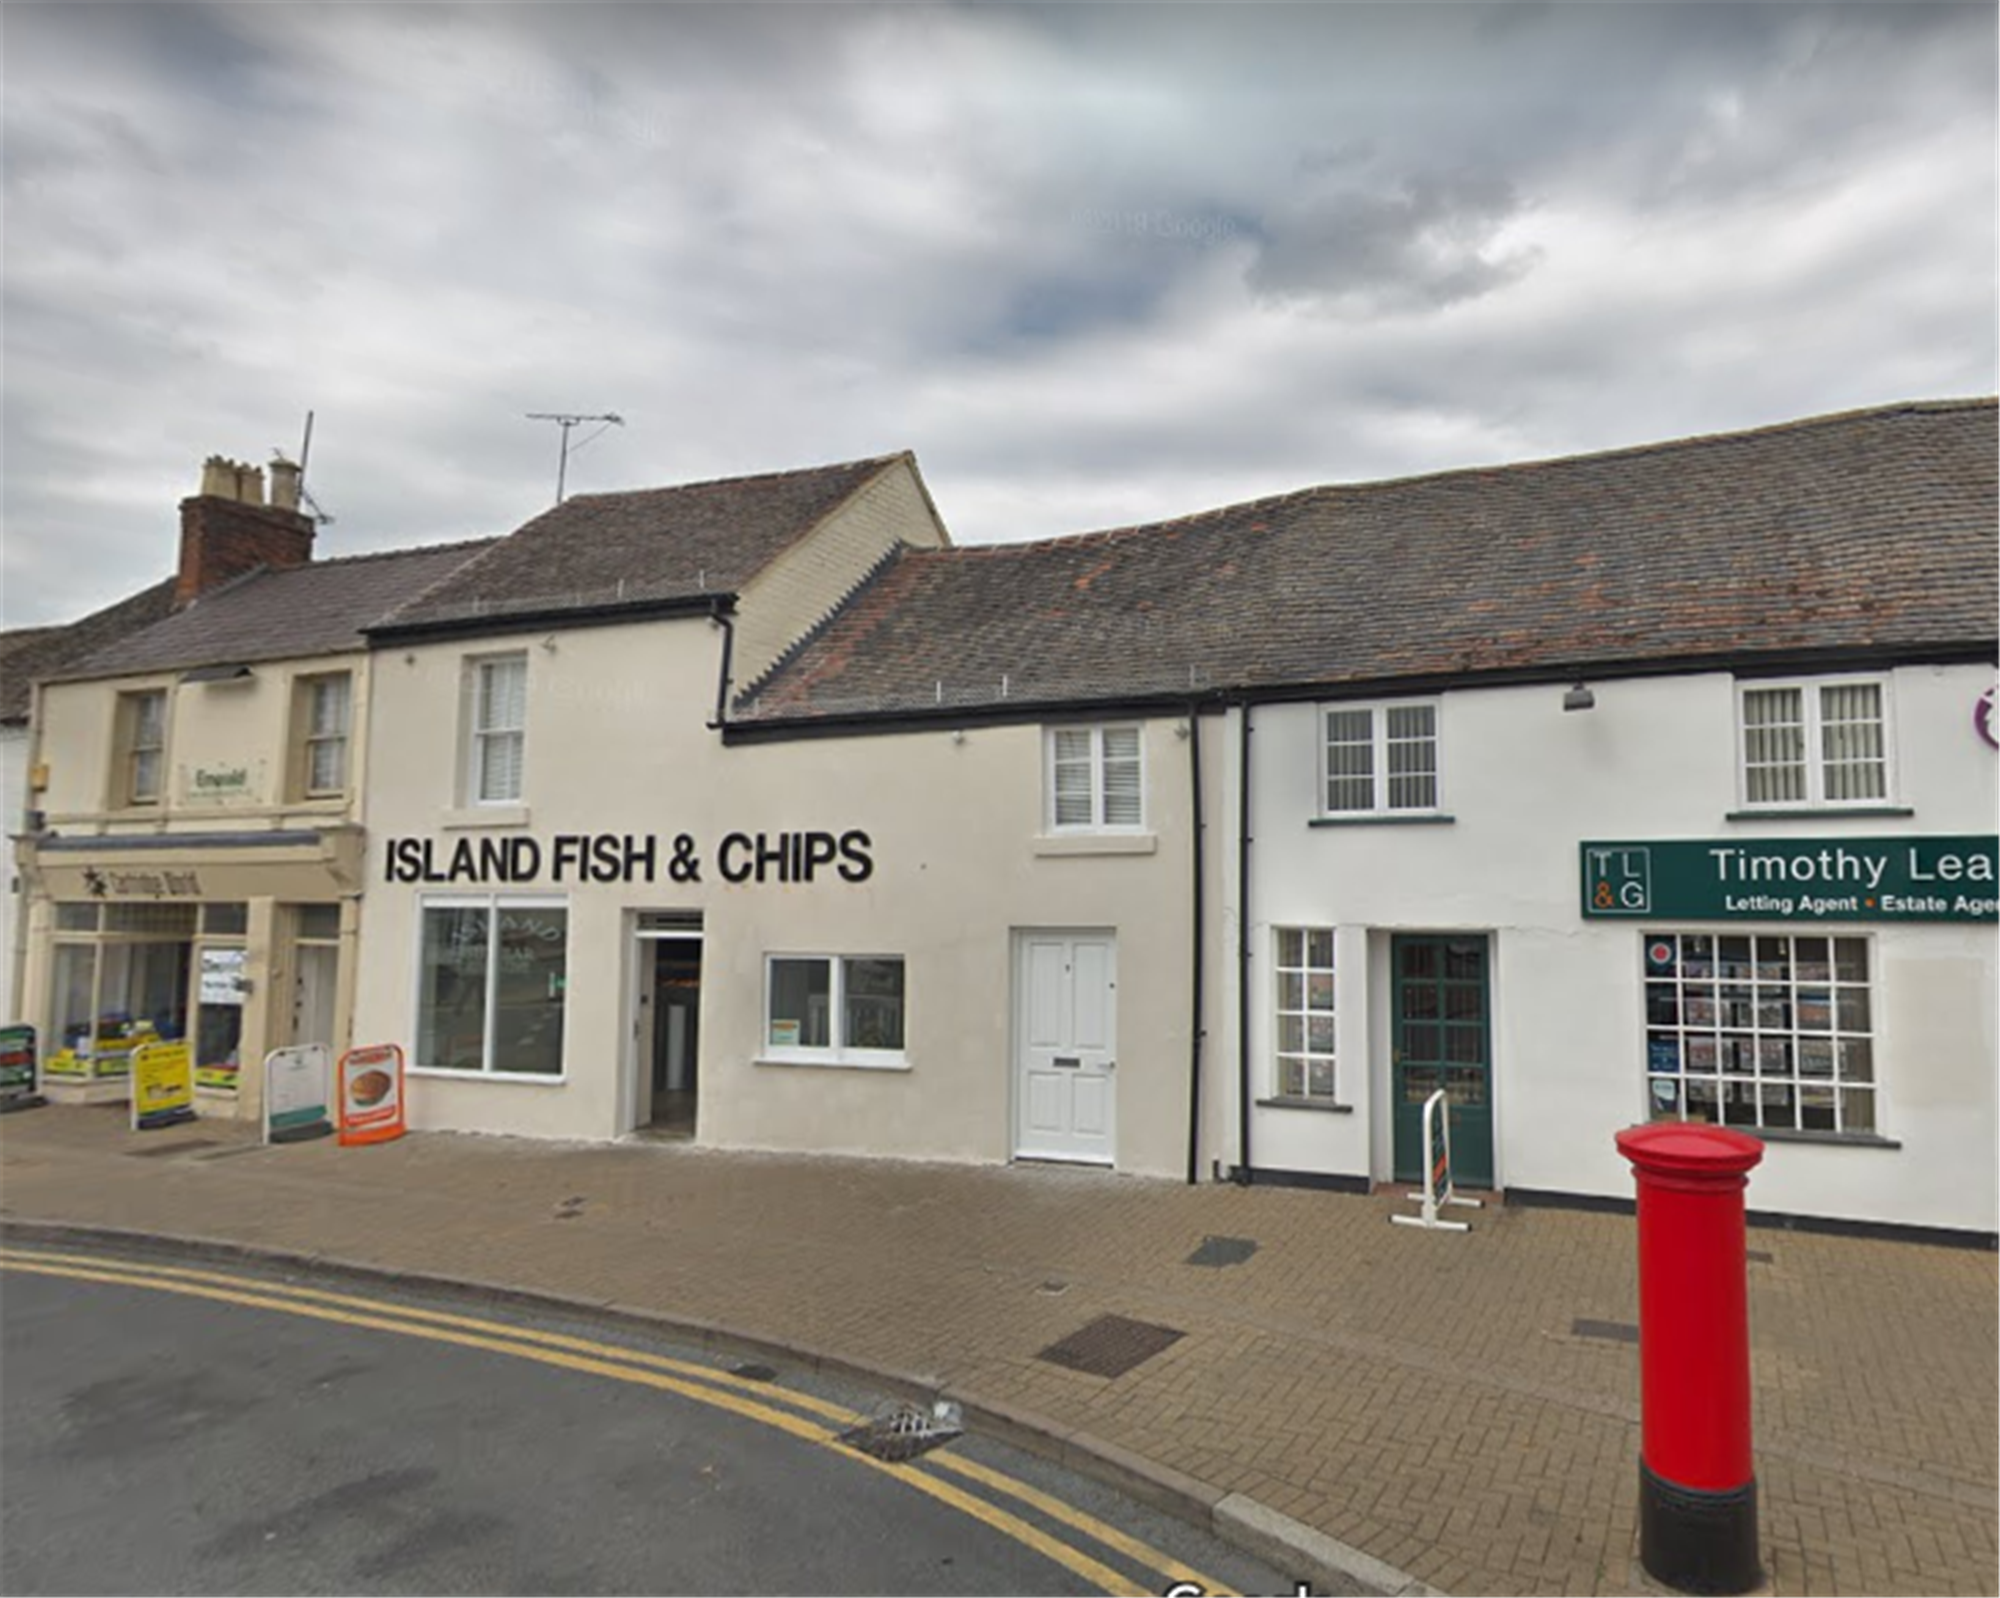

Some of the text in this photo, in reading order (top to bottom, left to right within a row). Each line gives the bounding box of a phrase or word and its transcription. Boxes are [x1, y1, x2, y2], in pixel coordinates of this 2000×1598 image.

[385, 830, 874, 883] ISLAND FISH & CHIPS
[1709, 848, 1994, 888] Timothy Lea
[1726, 895, 1793, 914] Letting
[1798, 895, 1858, 914] Agent
[1881, 895, 1947, 912] Estate
